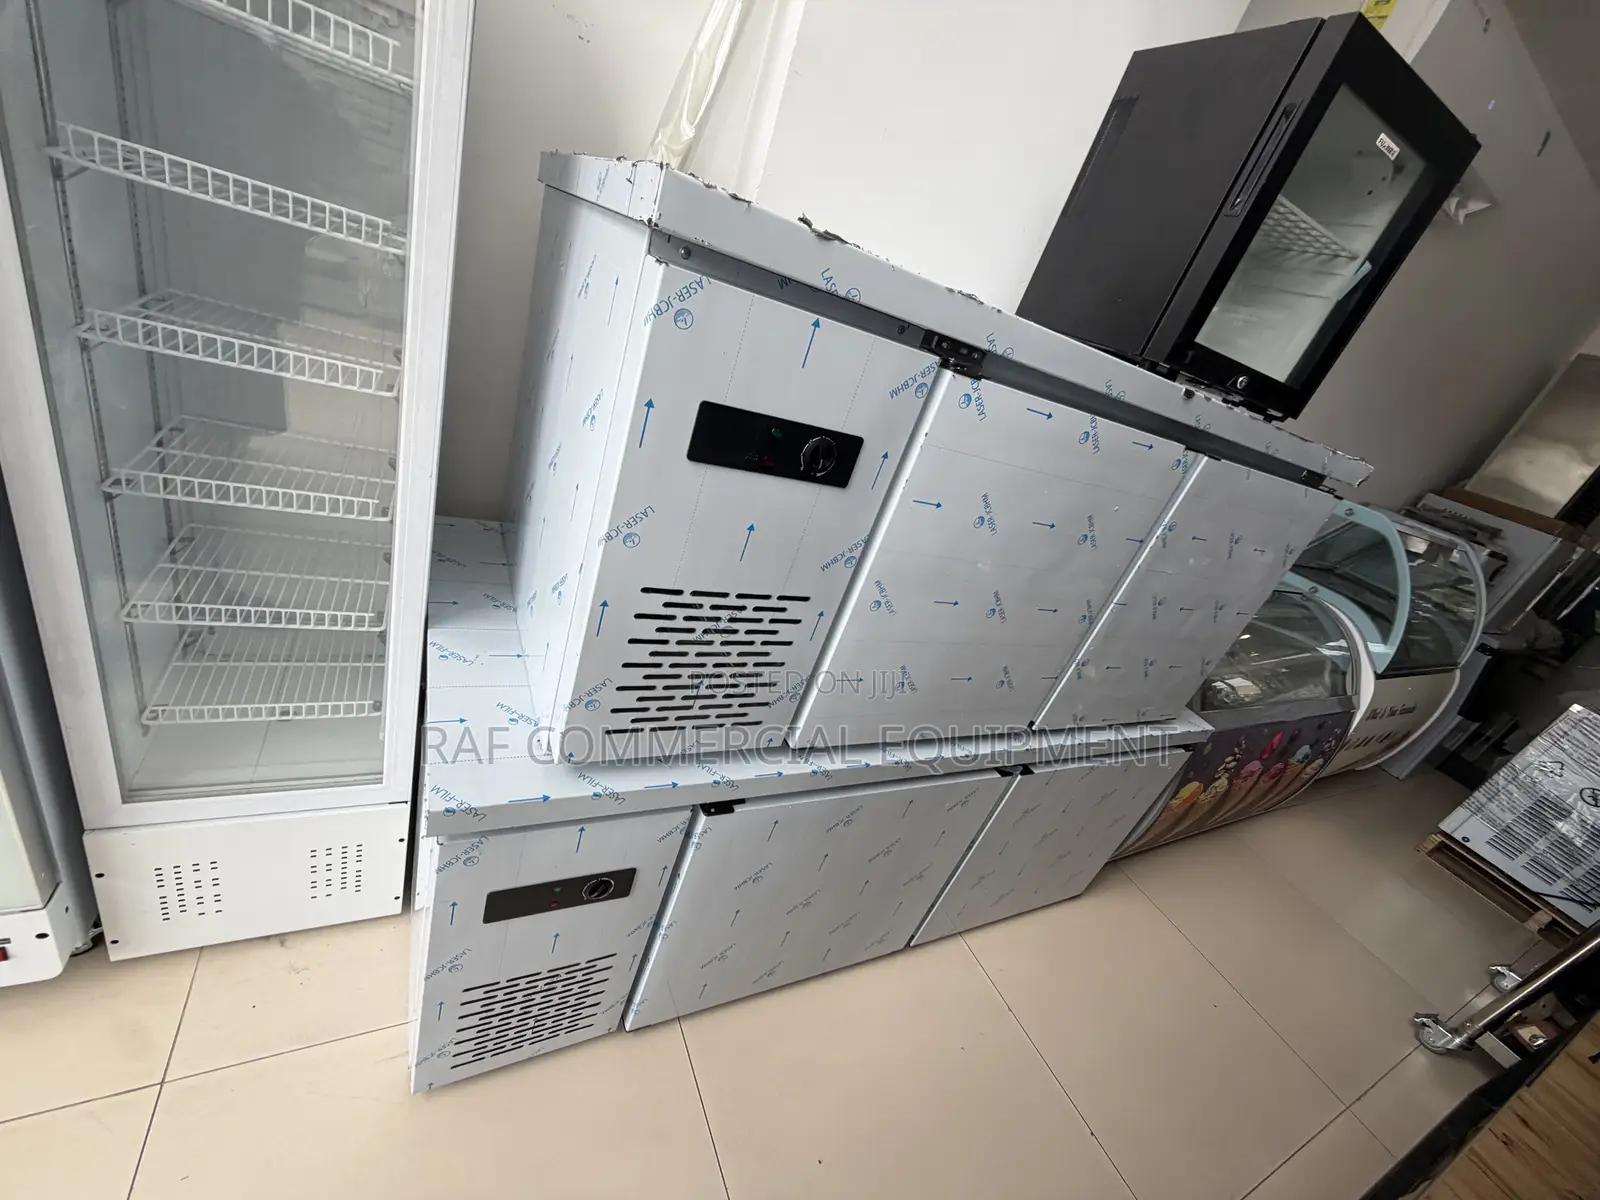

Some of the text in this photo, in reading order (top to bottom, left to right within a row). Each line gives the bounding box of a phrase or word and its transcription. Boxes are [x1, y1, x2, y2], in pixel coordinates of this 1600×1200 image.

[889, 360, 941, 400] ASER-JCBHM
[820, 534, 870, 572] ASER-JCBHM
[430, 784, 488, 822] LASER-FILM
[578, 771, 626, 806] LASER-FILM
